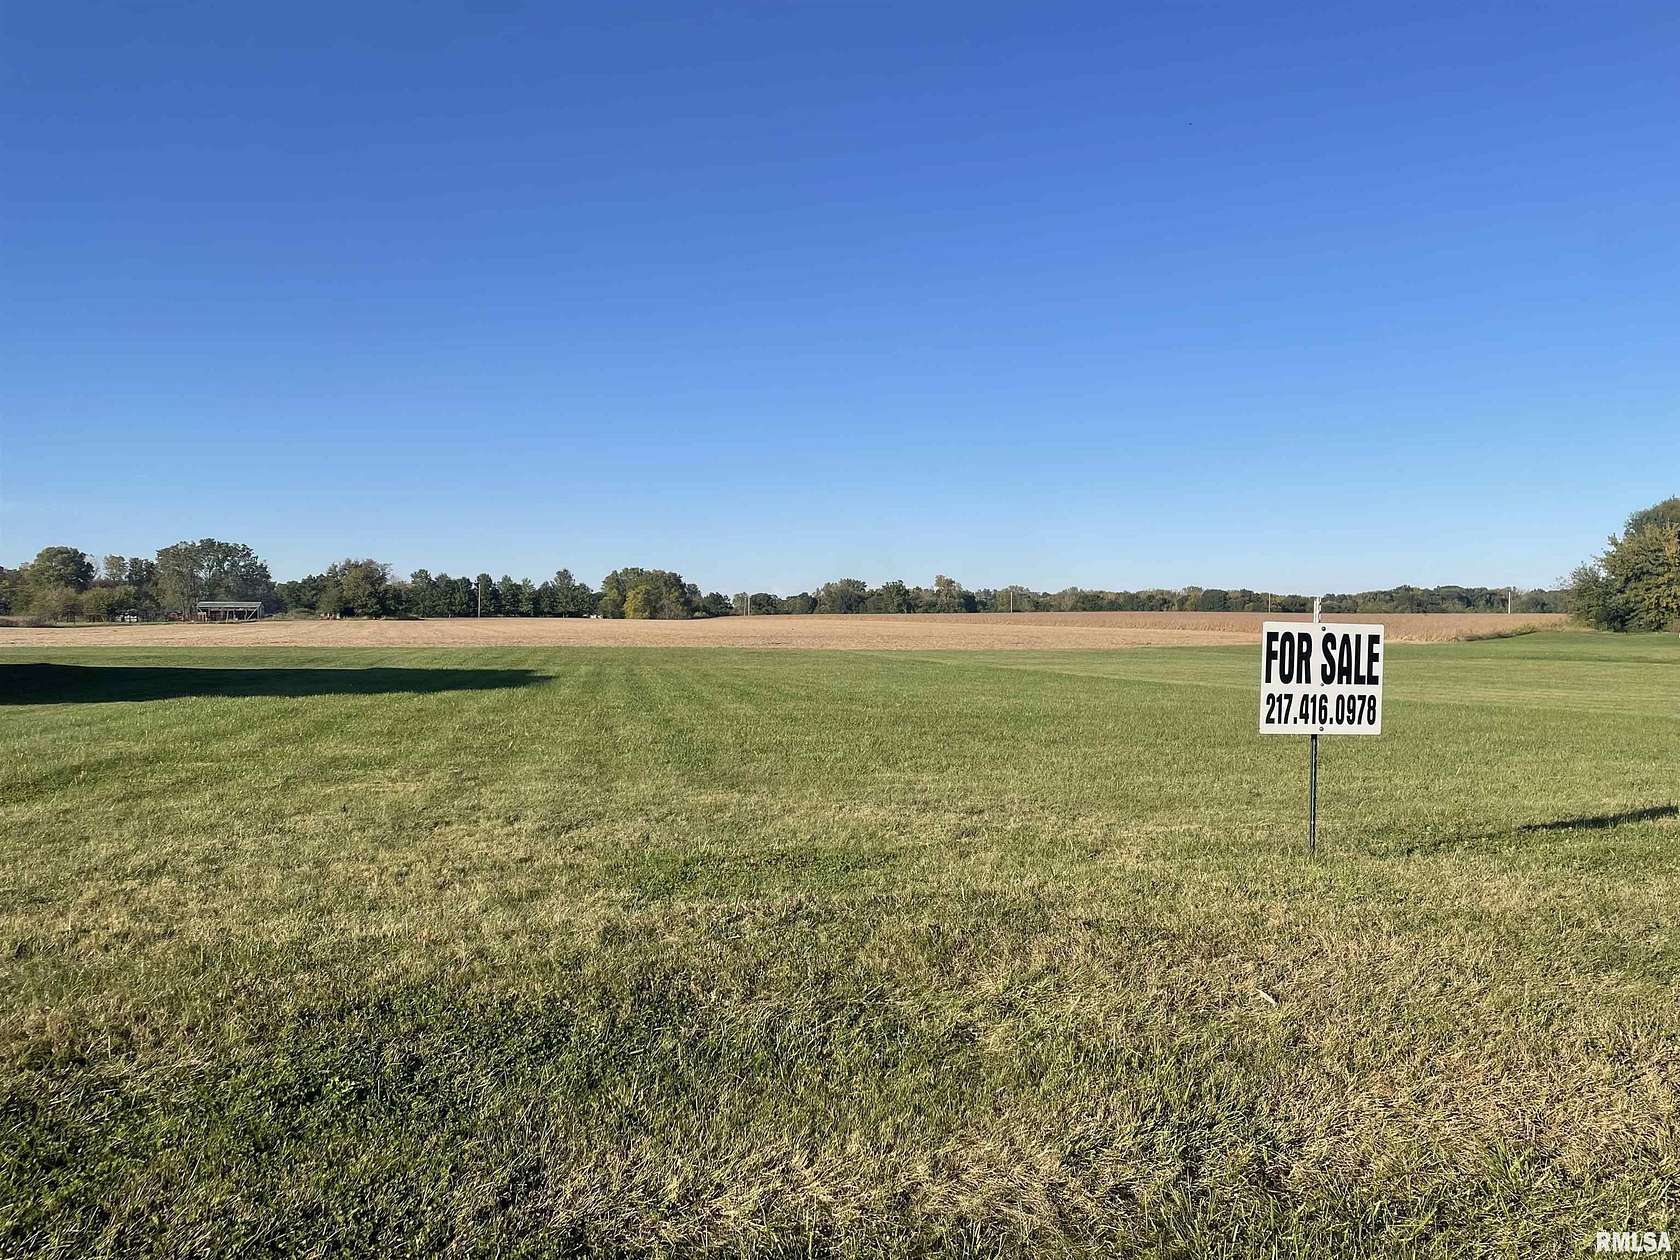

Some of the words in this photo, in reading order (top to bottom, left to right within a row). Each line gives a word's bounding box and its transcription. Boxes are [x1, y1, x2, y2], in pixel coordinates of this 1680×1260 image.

[1265, 632, 1312, 684] FOR
[1321, 633, 1380, 685] SALE
[1265, 693, 1377, 725] 217.416.0978
